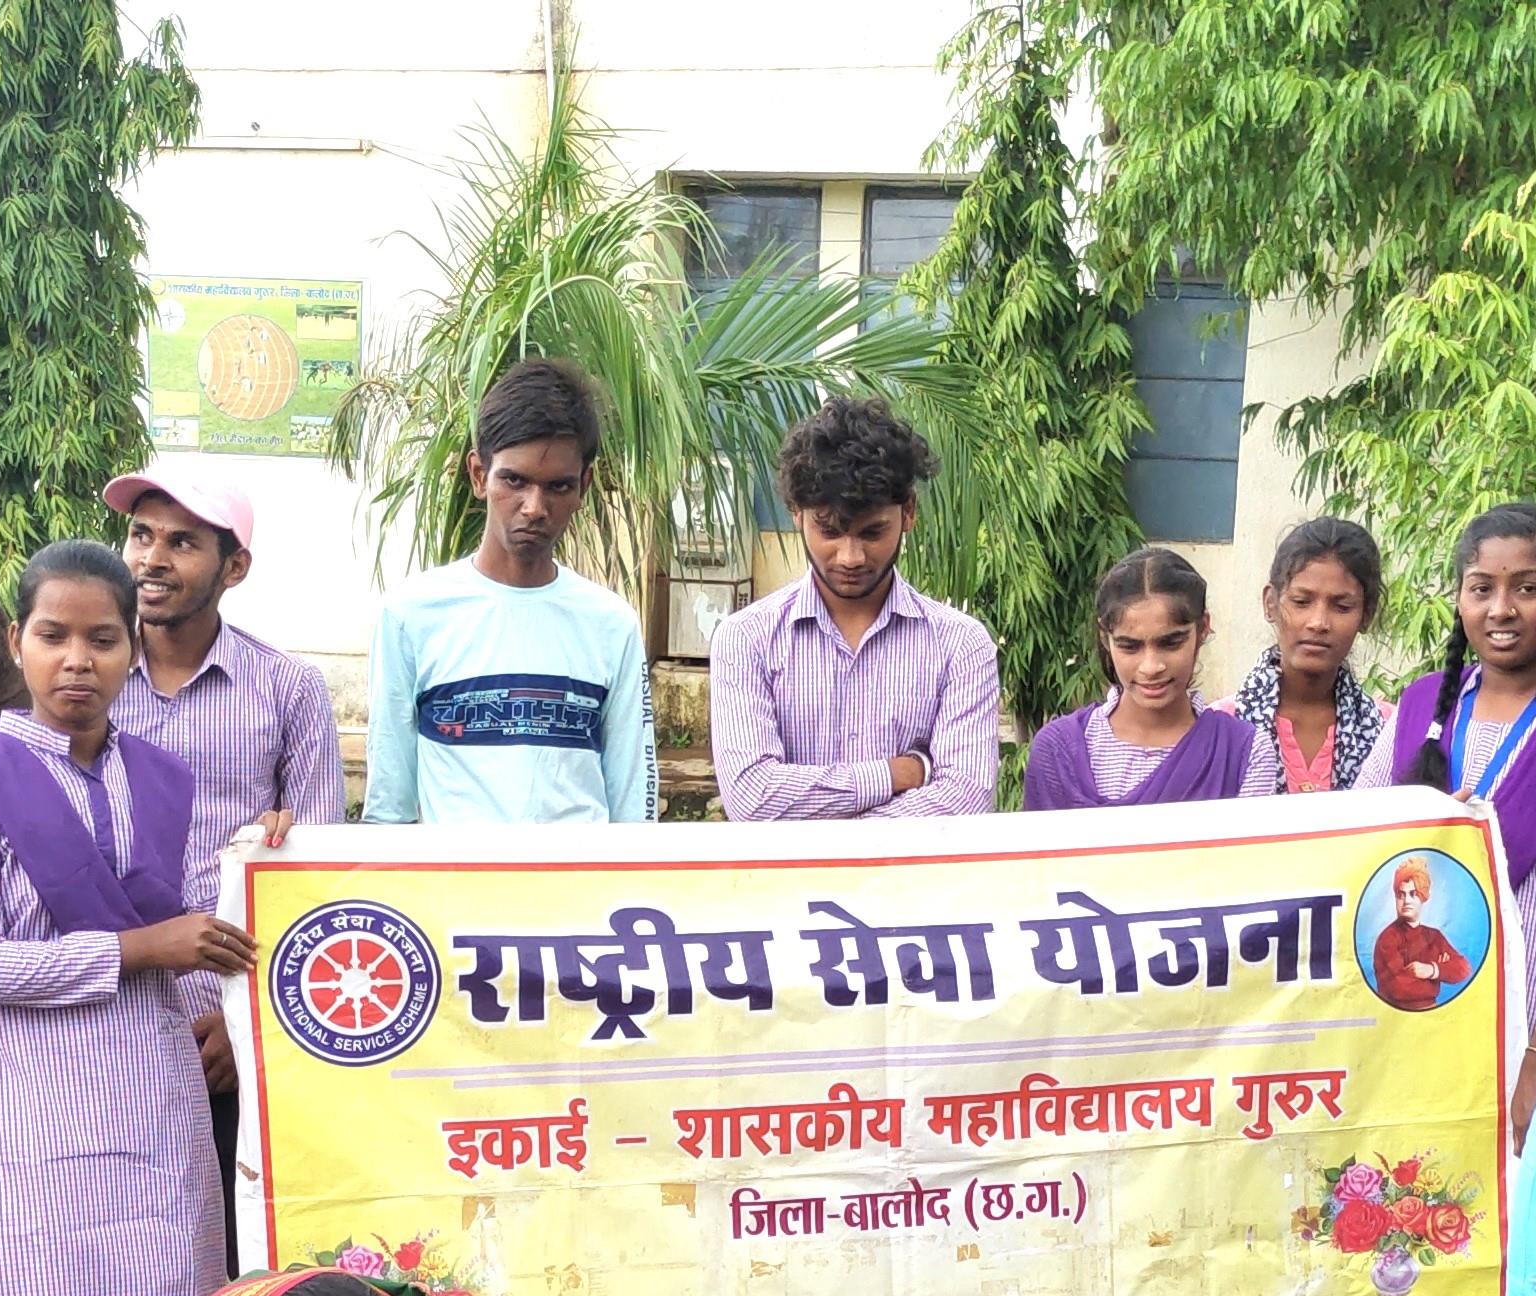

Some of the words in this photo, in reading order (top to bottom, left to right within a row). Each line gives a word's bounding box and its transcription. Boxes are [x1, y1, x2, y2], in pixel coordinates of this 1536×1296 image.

[645, 745, 656, 821] DIVISION
[330, 911, 376, 931] सेवा
[453, 907, 774, 1040] राष्ट्रीय
[799, 901, 995, 1007] सेवा
[1019, 891, 1343, 995] योजना
[283, 985, 331, 1046] NATIONAL
[333, 1030, 396, 1052] SERVICE
[394, 982, 428, 1036] SCHEME
[442, 1098, 588, 1178] इकाई
[673, 1082, 906, 1159] शासकीय
[923, 1072, 1214, 1147] महाविद्यालय
[1232, 1070, 1346, 1140] गुरुर
[965, 1172, 1087, 1232] (छ.ग.)
